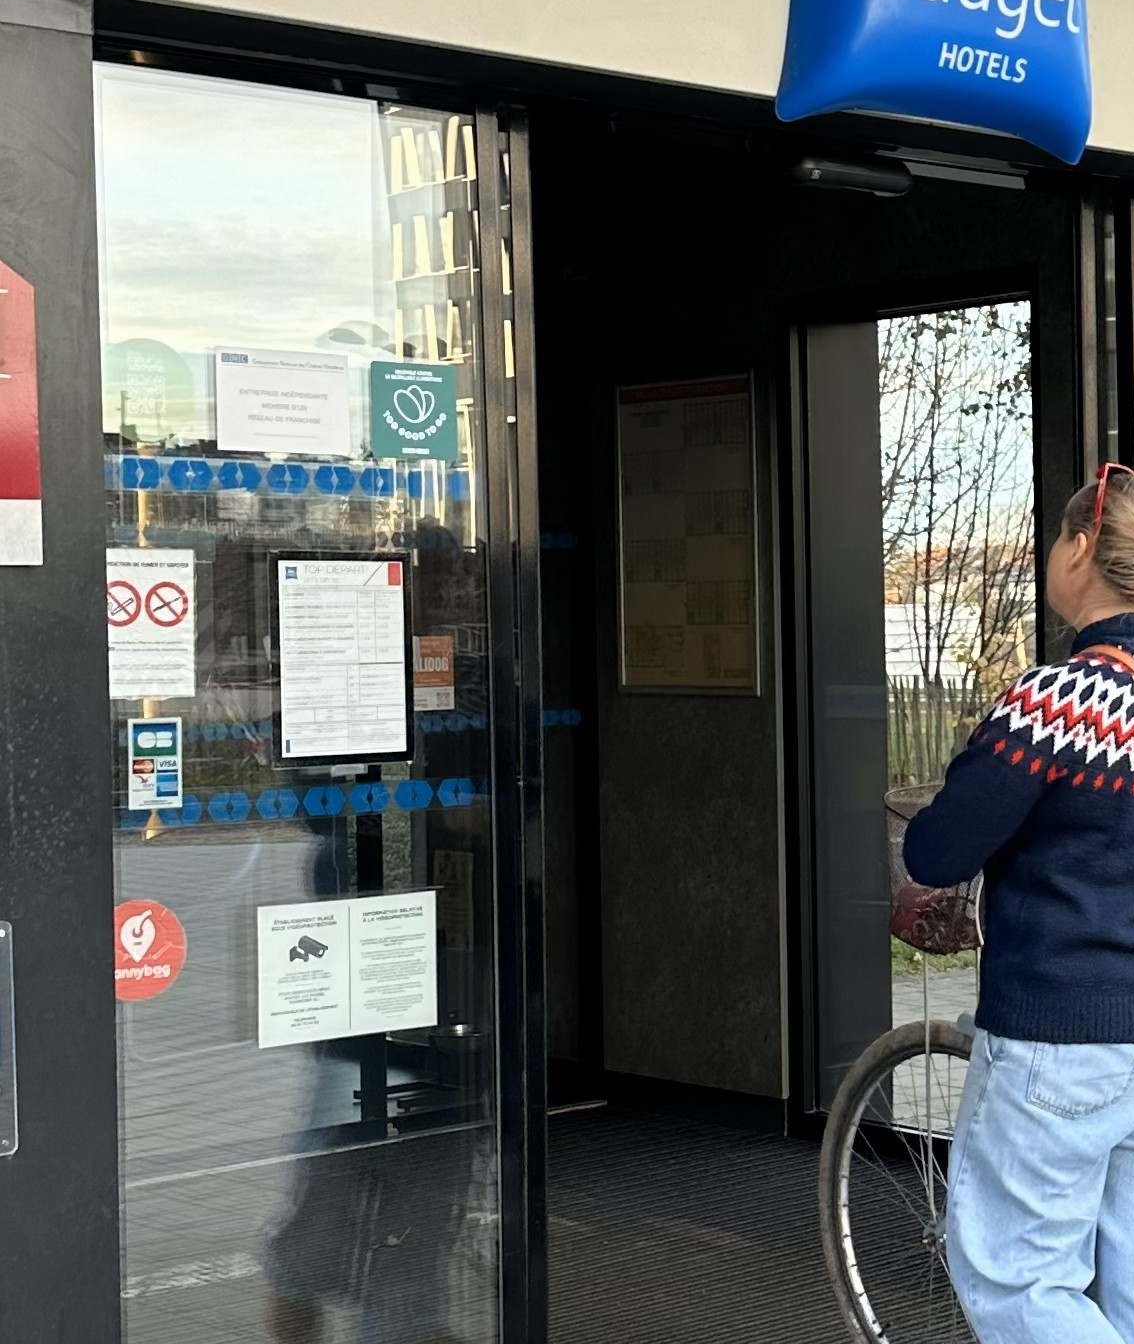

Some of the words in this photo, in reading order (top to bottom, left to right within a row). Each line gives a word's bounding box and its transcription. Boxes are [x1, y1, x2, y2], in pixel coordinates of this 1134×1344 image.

[938, 41, 1028, 83] HOTELS
[383, 410, 399, 430] TOO
[398, 427, 426, 441] GOOD
[424, 424, 437, 437] TO
[435, 412, 447, 427] GO
[137, 731, 173, 748] CB
[159, 759, 177, 768] VISA
[115, 964, 171, 980] annybag
